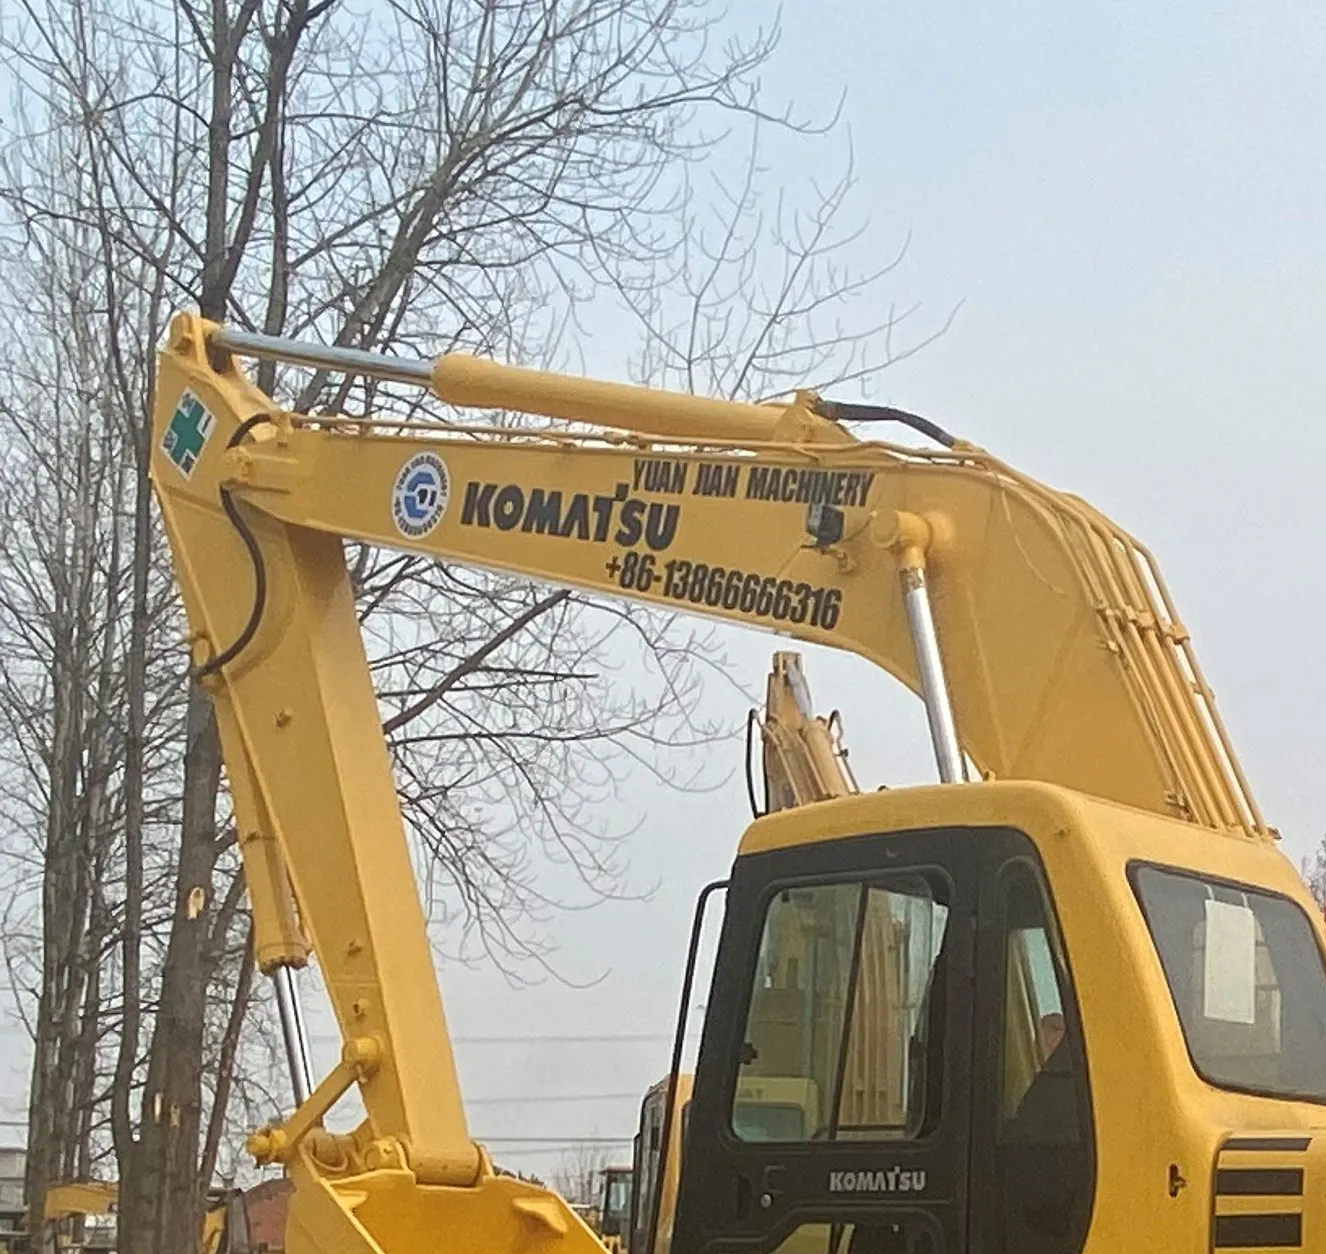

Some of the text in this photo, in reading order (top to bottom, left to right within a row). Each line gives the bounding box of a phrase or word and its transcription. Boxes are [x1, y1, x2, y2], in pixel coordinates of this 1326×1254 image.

[633, 459, 875, 507] YUAN JIAN MACHINERY
[460, 480, 680, 551] KOMATSU
[605, 551, 843, 630] +86-13866666316
[829, 1166, 926, 1192] KOMATSU
